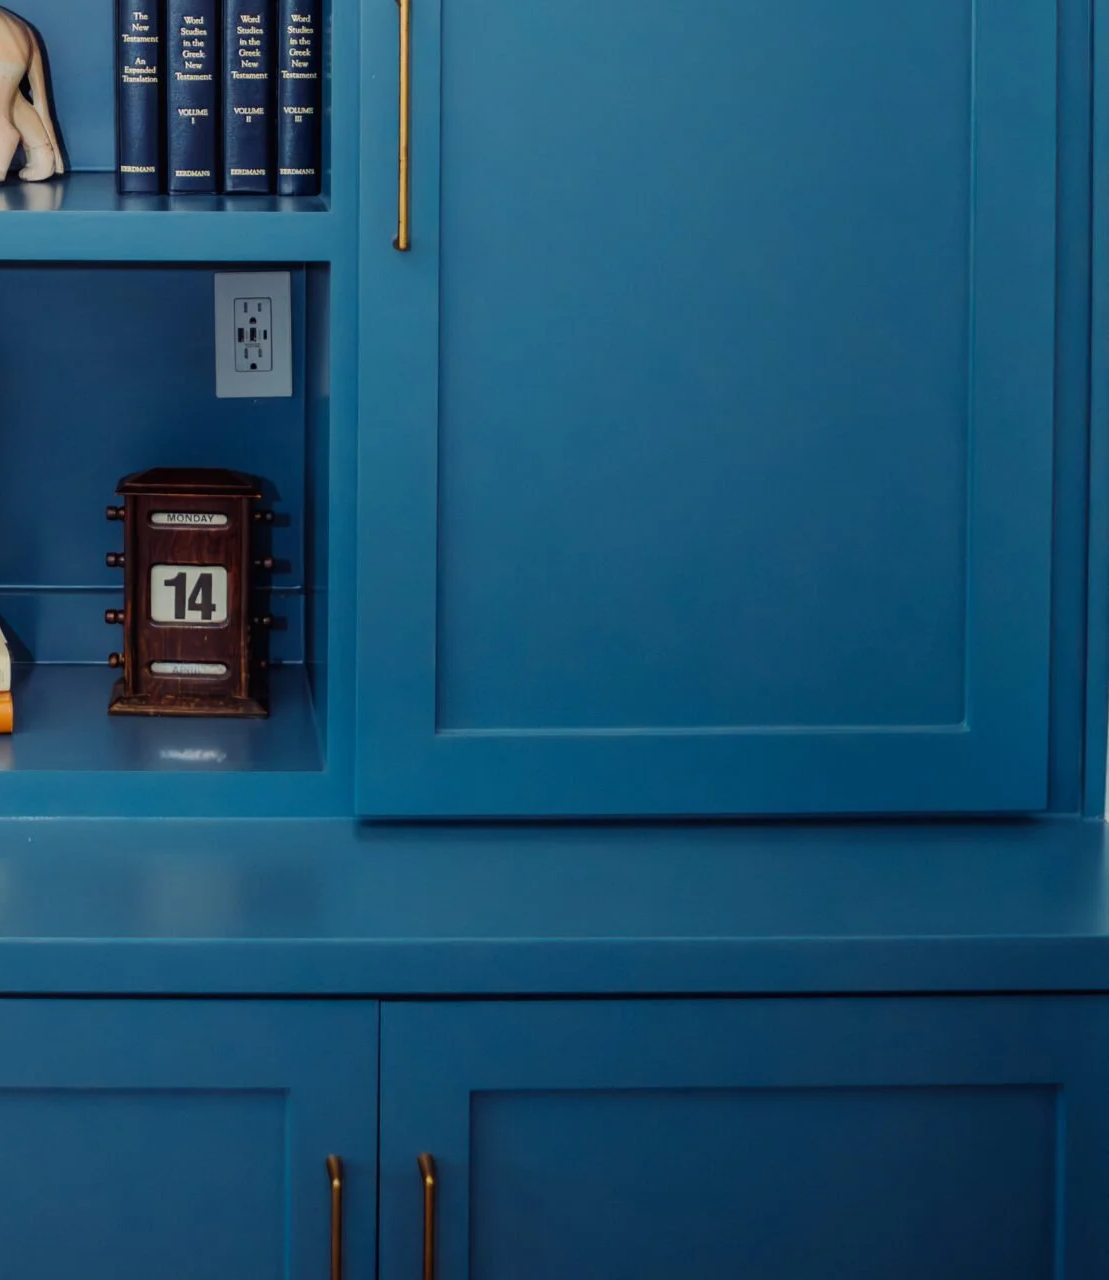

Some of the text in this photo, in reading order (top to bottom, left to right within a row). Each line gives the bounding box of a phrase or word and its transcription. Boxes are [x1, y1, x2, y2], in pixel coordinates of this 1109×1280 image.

[133, 11, 149, 21] The
[183, 16, 204, 25] Word
[240, 14, 261, 23] Word
[290, 14, 311, 23] Word
[132, 23, 150, 31] New
[180, 27, 208, 36] Studies
[236, 26, 264, 35] Studies
[287, 25, 314, 34] Studies
[122, 34, 159, 43] Testament
[183, 38, 205, 47] in the
[239, 37, 261, 46] in the
[289, 36, 311, 46] in the
[182, 49, 206, 58] Greek
[238, 48, 261, 57] Greek
[288, 47, 311, 57] Greek
[135, 57, 146, 65] An
[184, 61, 203, 69] New
[241, 59, 259, 68] New
[291, 59, 309, 68] New
[124, 65, 156, 74] Expanded
[122, 74, 158, 83] Translation
[175, 72, 212, 81] Testament
[231, 70, 268, 79] Testament
[281, 70, 318, 79] Testament
[177, 108, 209, 117] VOLUME
[233, 107, 265, 115] VOLUME
[283, 106, 314, 114] VOLUME
[191, 116, 196, 125] I
[245, 115, 252, 123] II
[294, 115, 303, 123] III
[167, 513, 215, 523] MONDAY
[164, 572, 217, 620] 14
